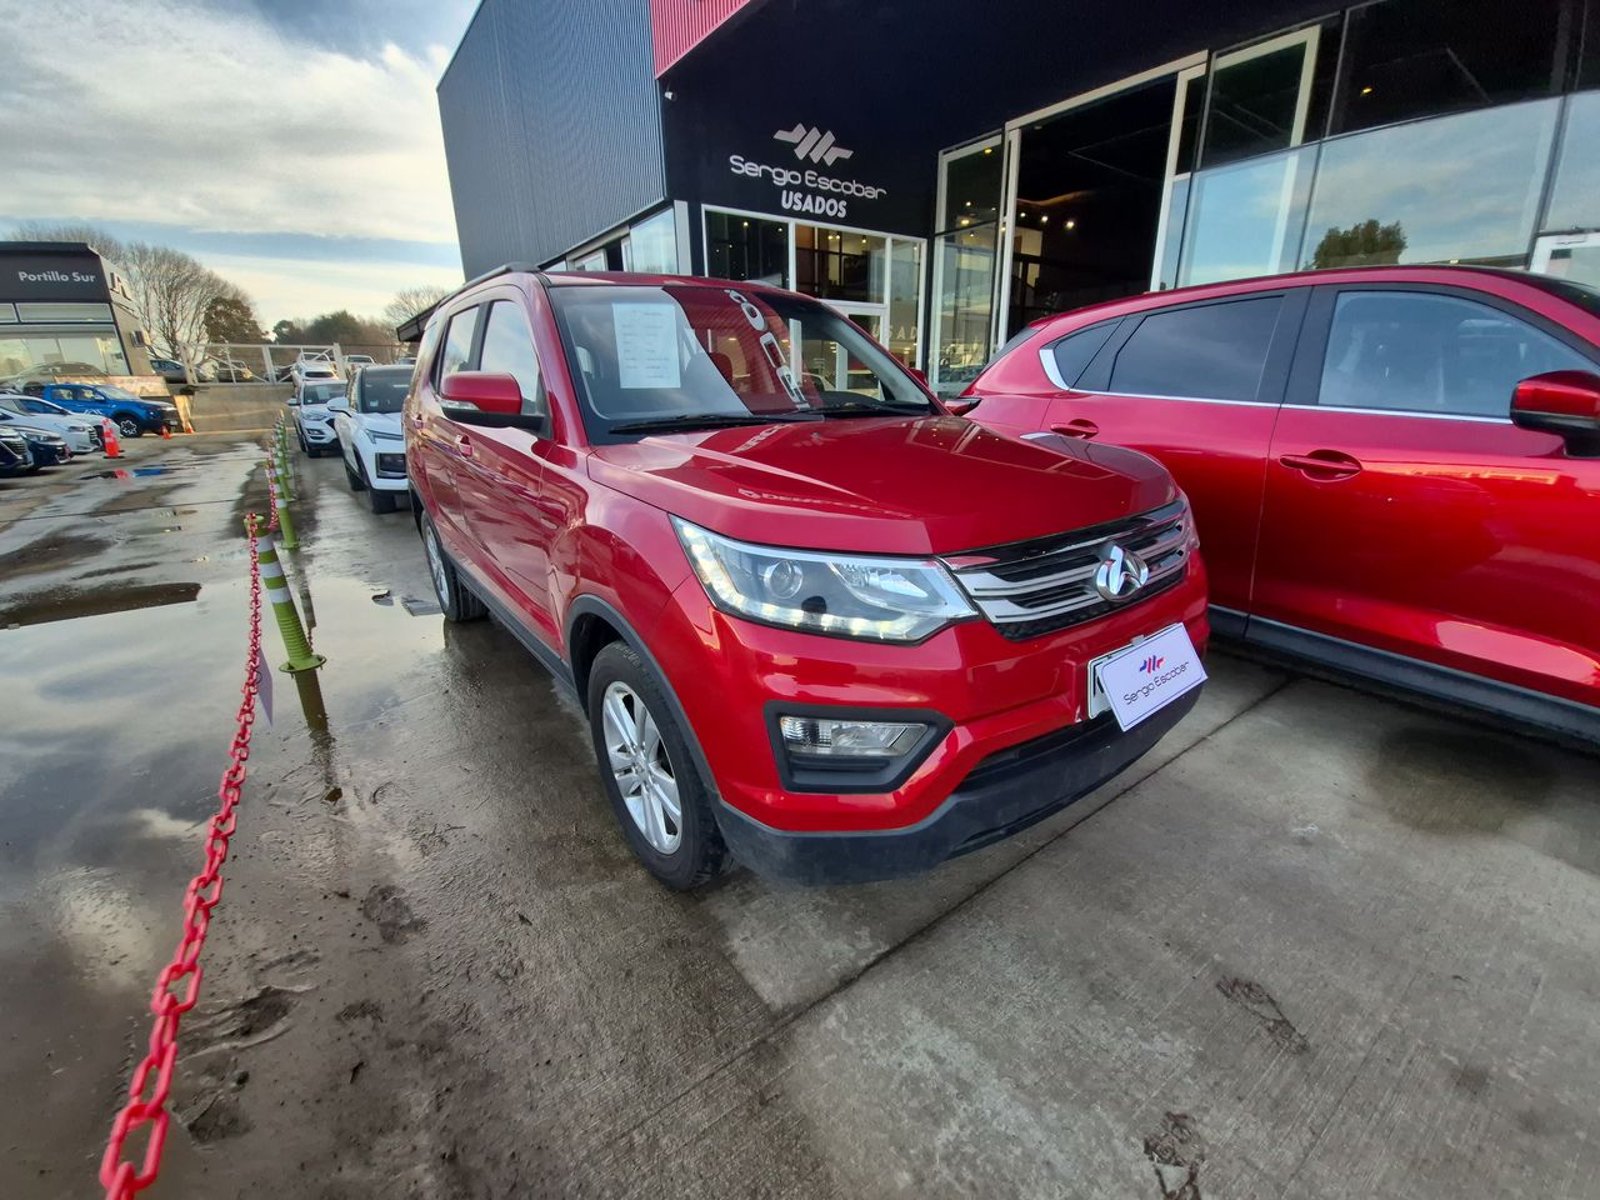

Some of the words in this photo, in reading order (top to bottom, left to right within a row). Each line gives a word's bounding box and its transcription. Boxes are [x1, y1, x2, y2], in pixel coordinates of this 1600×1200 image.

[729, 155, 802, 186] Sergio
[804, 170, 887, 200] Escobar
[781, 190, 847, 218] USADOS
[18, 271, 69, 281] Portillo
[72, 271, 96, 282] Sur
[1123, 682, 1155, 705] Sergio
[1153, 661, 1189, 687] Escobar
